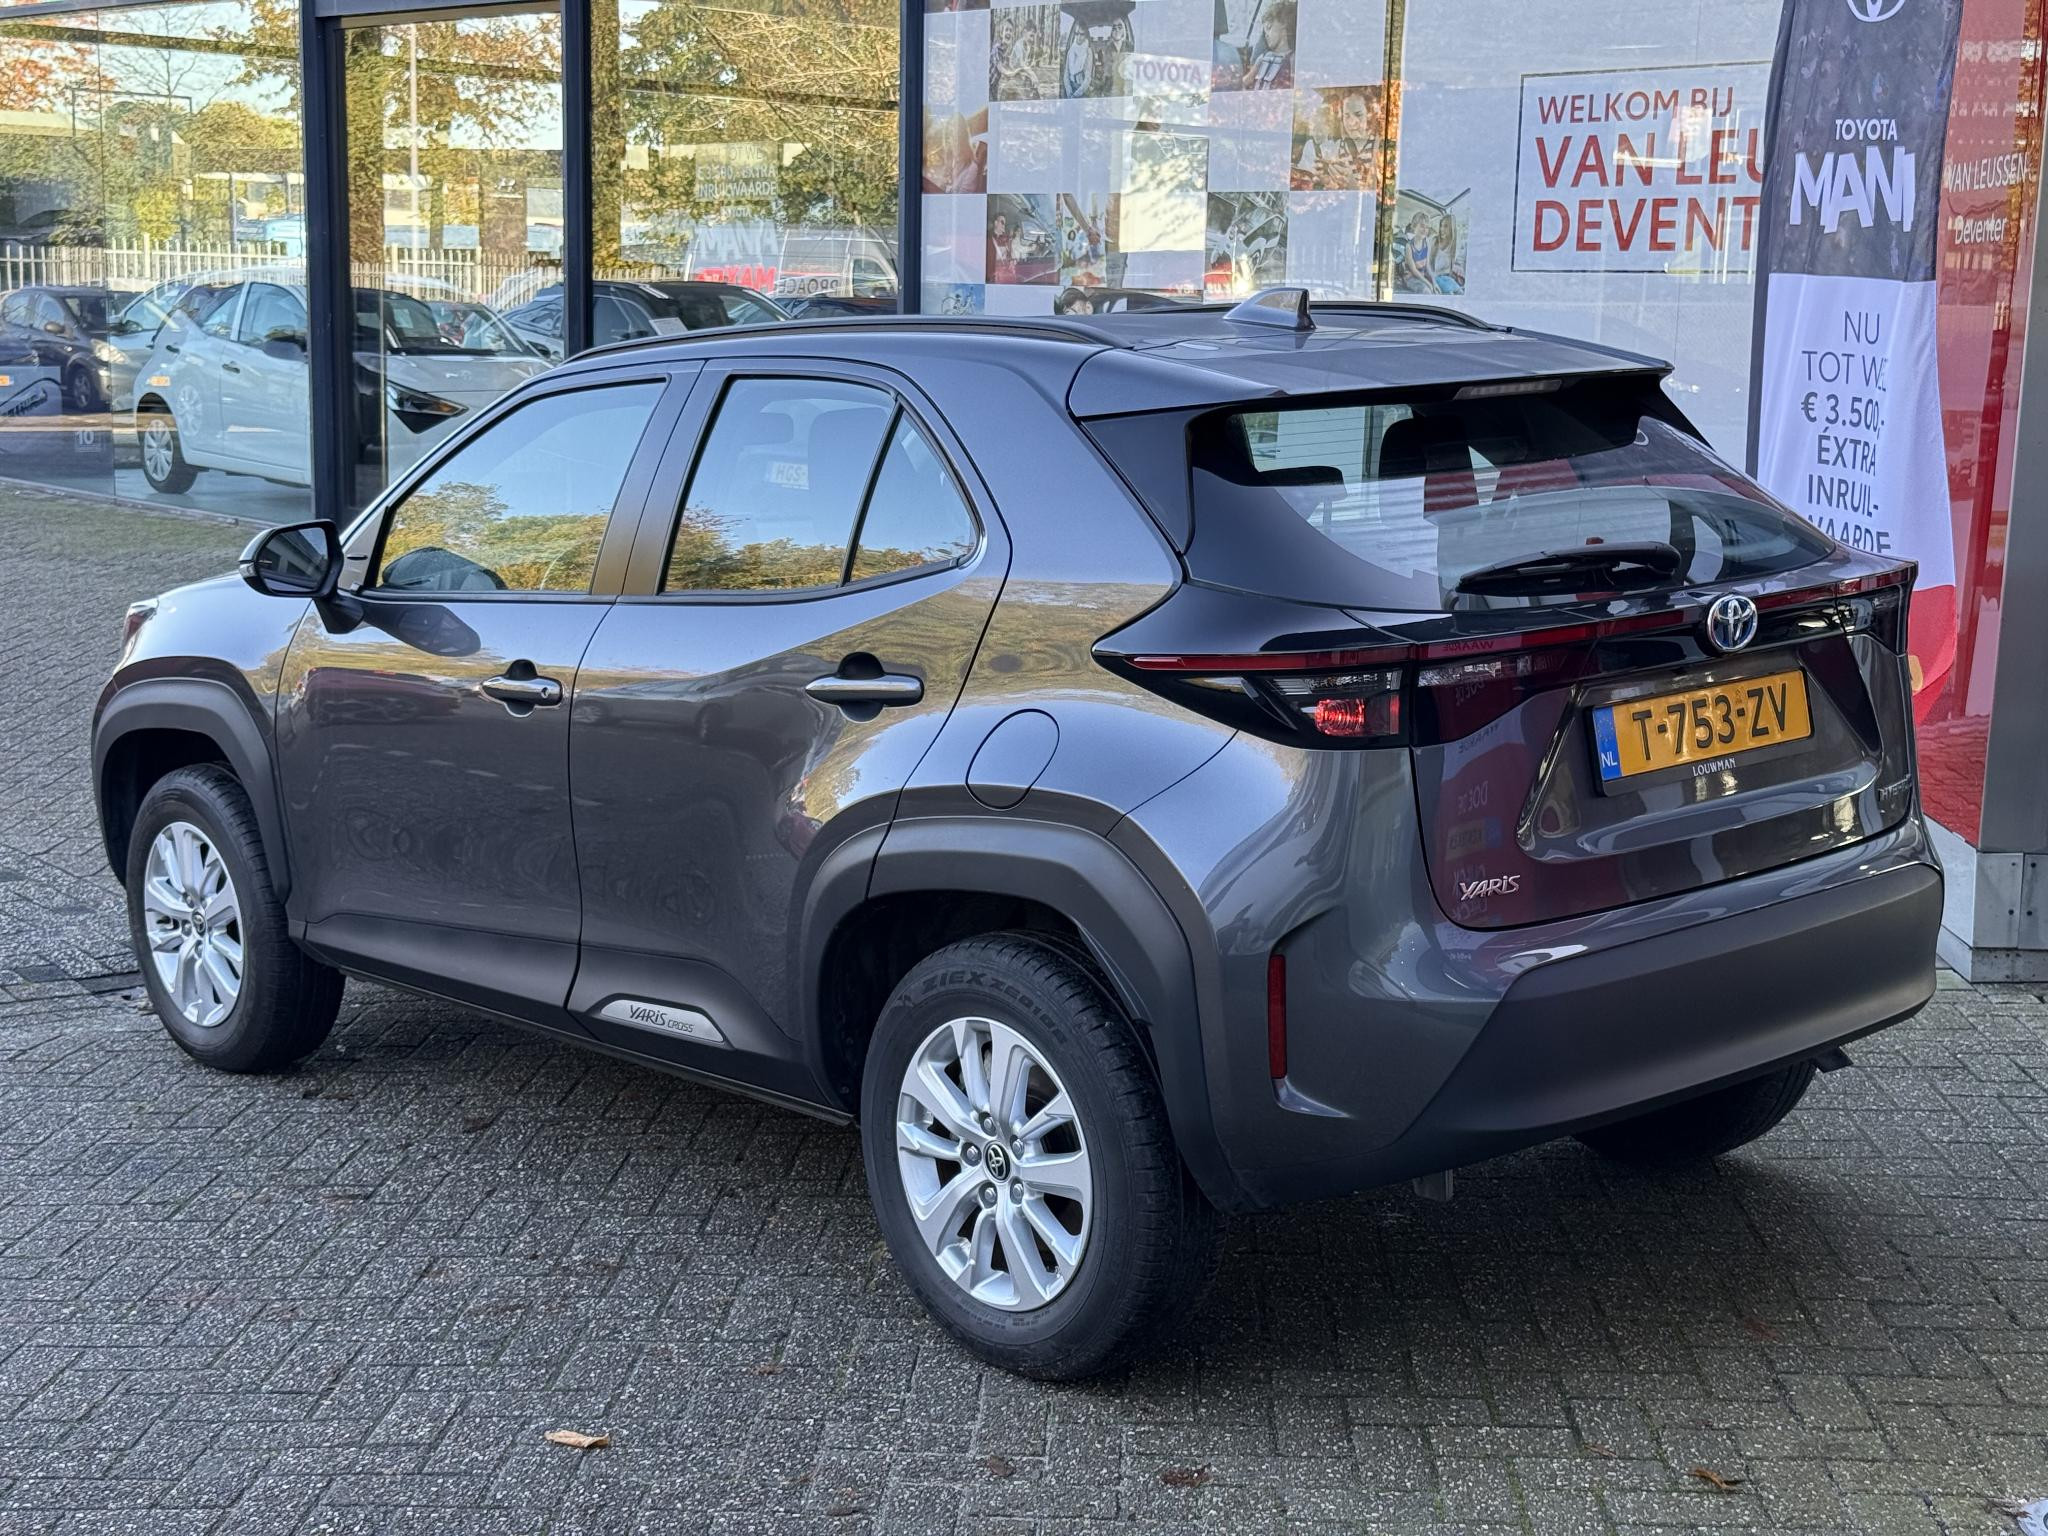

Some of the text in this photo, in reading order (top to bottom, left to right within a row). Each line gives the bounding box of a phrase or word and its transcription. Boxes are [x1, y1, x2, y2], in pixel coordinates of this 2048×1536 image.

[1133, 61, 1202, 84] TOYOTA
[1538, 86, 1733, 124] WELKOM BIJ
[1836, 119, 1898, 141] TOYOTA
[1535, 132, 1656, 188] VAN
[1947, 150, 2027, 193] VAN LEUSSEN
[1955, 209, 2007, 244] Deventer
[1844, 311, 1880, 345] NU
[1802, 350, 1855, 385] TOT
[1801, 391, 1818, 423] €
[1817, 426, 1876, 477] ÉXTRA
[1808, 474, 1879, 518] INRUIL-
[1632, 683, 1787, 761] T-753-ZV
[1601, 753, 1618, 768] NL
[1692, 757, 1736, 778] LOUWMAN
[922, 970, 987, 996] ZIEX
[667, 1019, 694, 1033] CROSS
